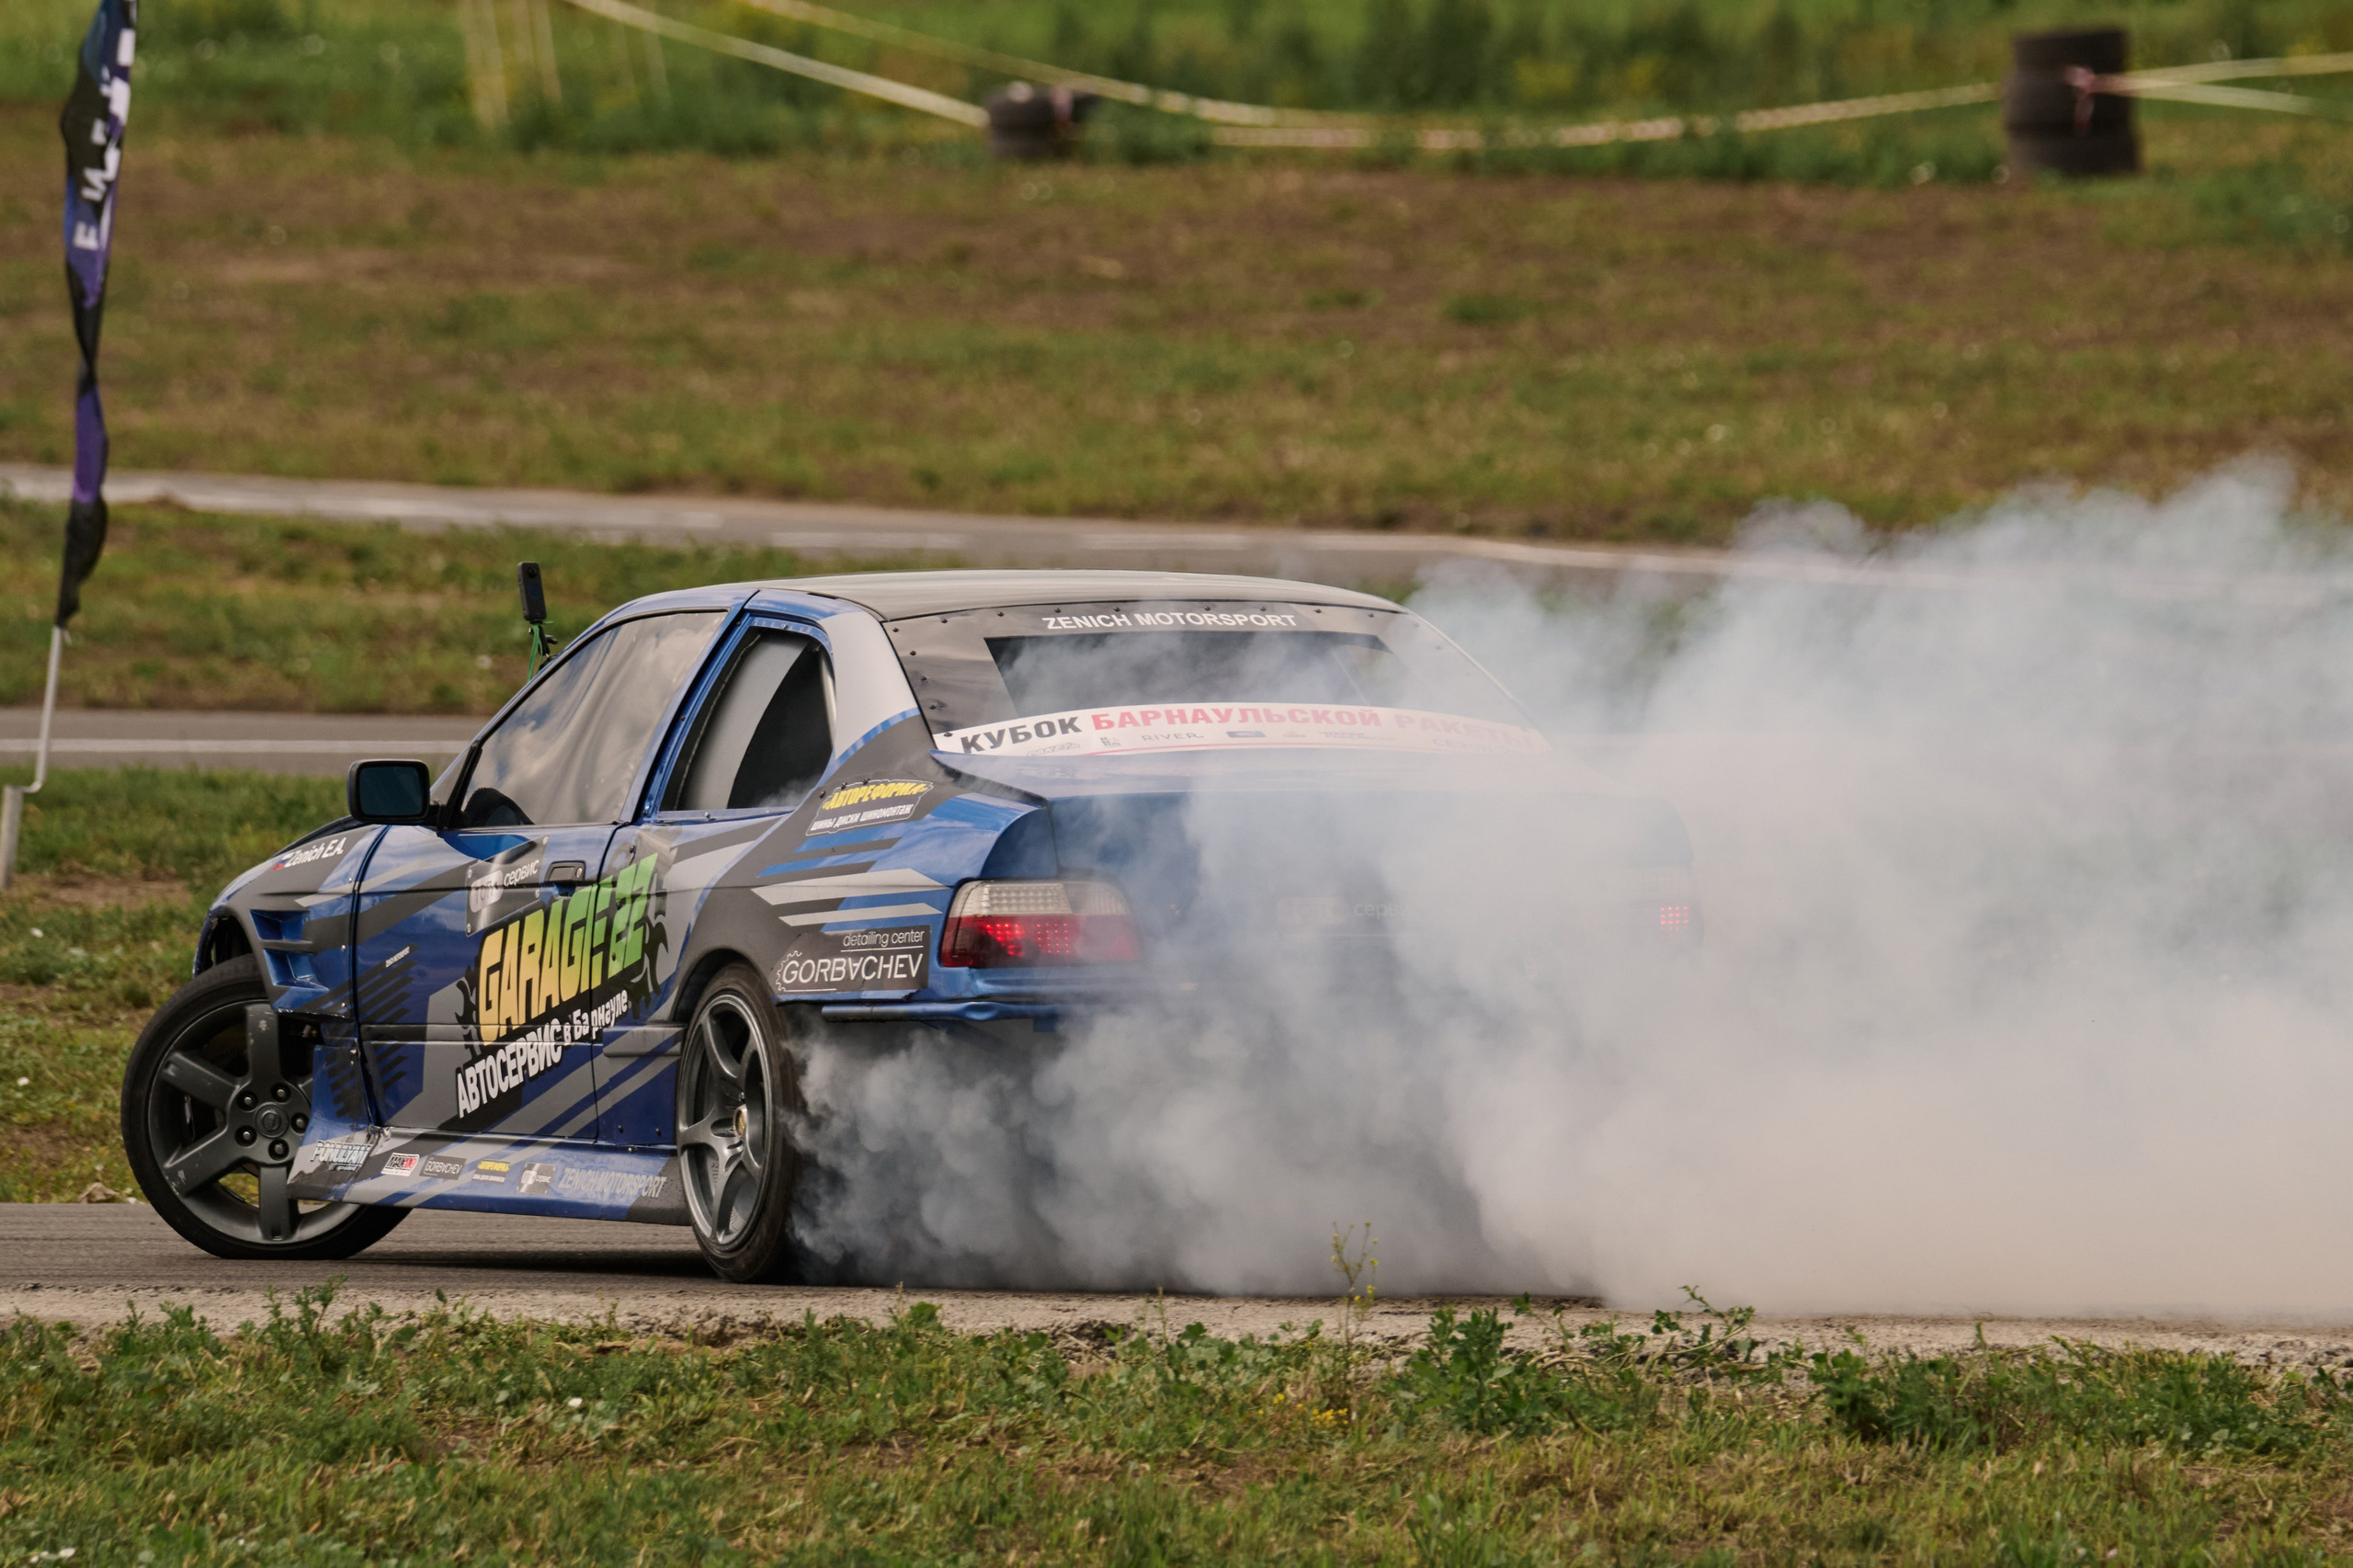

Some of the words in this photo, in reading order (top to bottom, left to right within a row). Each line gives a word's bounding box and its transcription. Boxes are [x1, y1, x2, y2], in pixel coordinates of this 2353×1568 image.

[1041, 614, 1132, 631] ZENICH
[1133, 612, 1298, 627] MOTORSPORT
[961, 716, 1083, 754] КУБОК
[1091, 708, 1382, 731] БАРНАУЛЬСКОЙ
[1141, 733, 1204, 742] RIVER
[284, 843, 325, 869] Zenich
[322, 837, 347, 858] E.A.
[503, 859, 540, 887] сервис
[843, 930, 889, 948] detailing
[891, 929, 925, 943] center
[479, 875, 614, 1046] GARAGE
[457, 1017, 563, 1119] АВТОСЕРВИС
[573, 989, 628, 1040] Барнауле
[597, 1170, 668, 1198] MOTORSPORT
